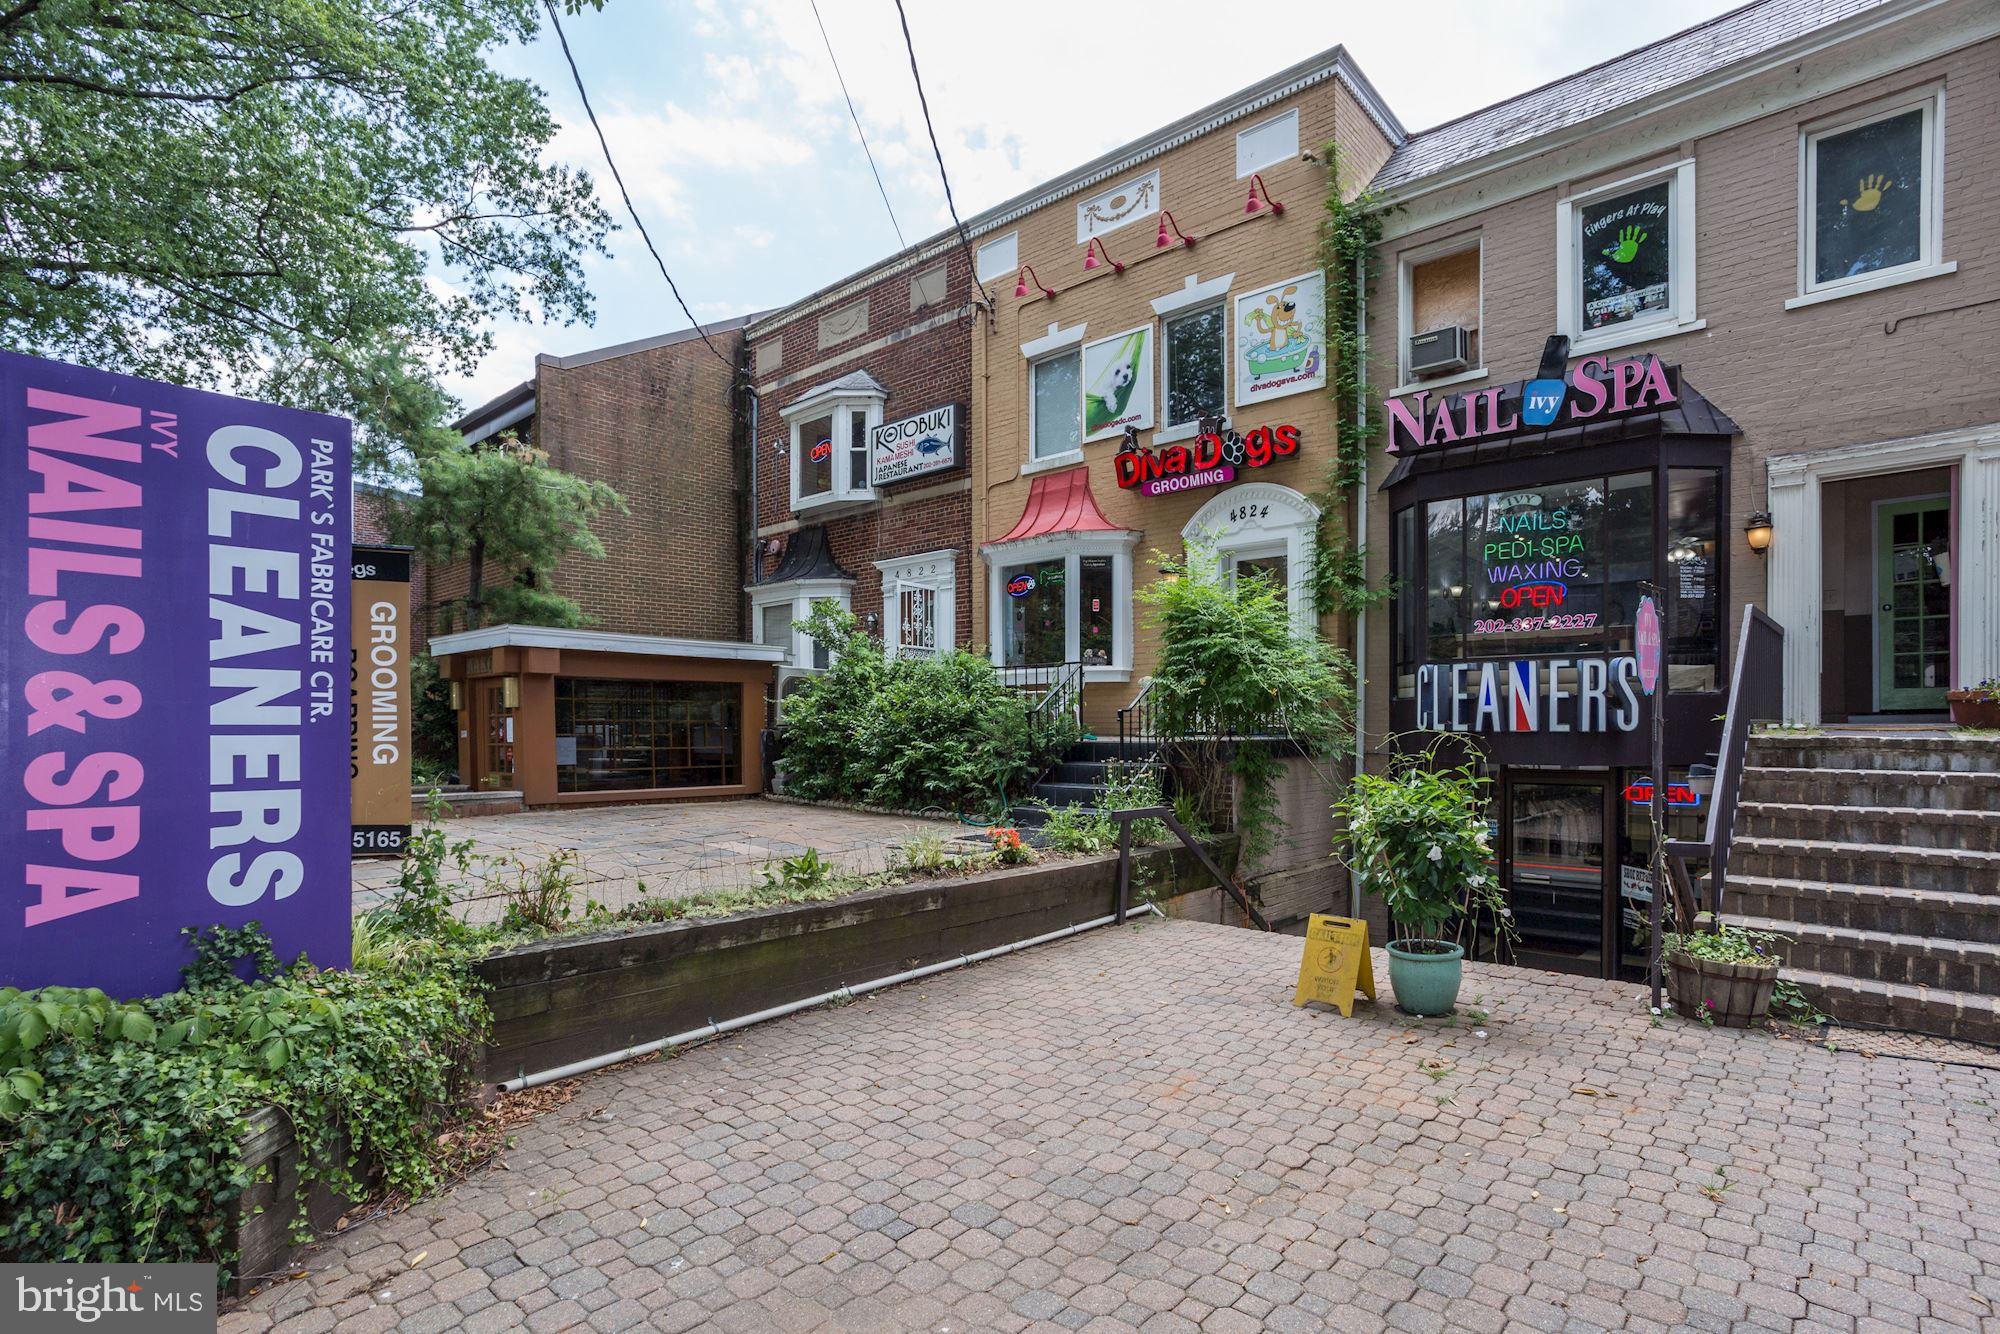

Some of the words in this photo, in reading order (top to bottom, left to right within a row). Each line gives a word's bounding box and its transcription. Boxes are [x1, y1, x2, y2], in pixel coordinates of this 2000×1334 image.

[1584, 209, 1624, 237] Fingers
[1626, 204, 1639, 217] At
[1640, 203, 1667, 218] Play
[1384, 386, 1518, 453] NAIL
[1570, 354, 1678, 420] SPA
[149, 410, 178, 458] IVY
[876, 408, 950, 453] KOTOBUKI
[810, 442, 832, 460] OPEN
[896, 439, 915, 451] SUSHI
[875, 459, 907, 481] JAPANESE
[878, 463, 923, 480] RESTAURANT
[1114, 445, 1189, 488] Diva
[1151, 469, 1225, 495] GROOMING
[1230, 504, 1269, 523] 4824
[1507, 495, 1535, 506] IVY
[25, 387, 146, 655] NAILS
[1499, 511, 1566, 534] NAILS
[1484, 535, 1585, 561] PEDI-SPA
[350, 562, 377, 579] gs
[895, 564, 936, 578] 4822
[1488, 559, 1584, 584] WAXING
[311, 532, 335, 664] FABRICARE
[1008, 580, 1027, 593] OPEN
[1501, 585, 1564, 608] OPEN
[1474, 613, 1598, 634] 202-337-2227
[206, 425, 303, 906] CLEANERS
[311, 669, 335, 723] CTR.
[370, 601, 399, 765] GROOMING
[1417, 656, 1639, 732] CLEANERS
[25, 671, 143, 735] &
[24, 751, 145, 928] SPA
[352, 830, 401, 848] 5165
